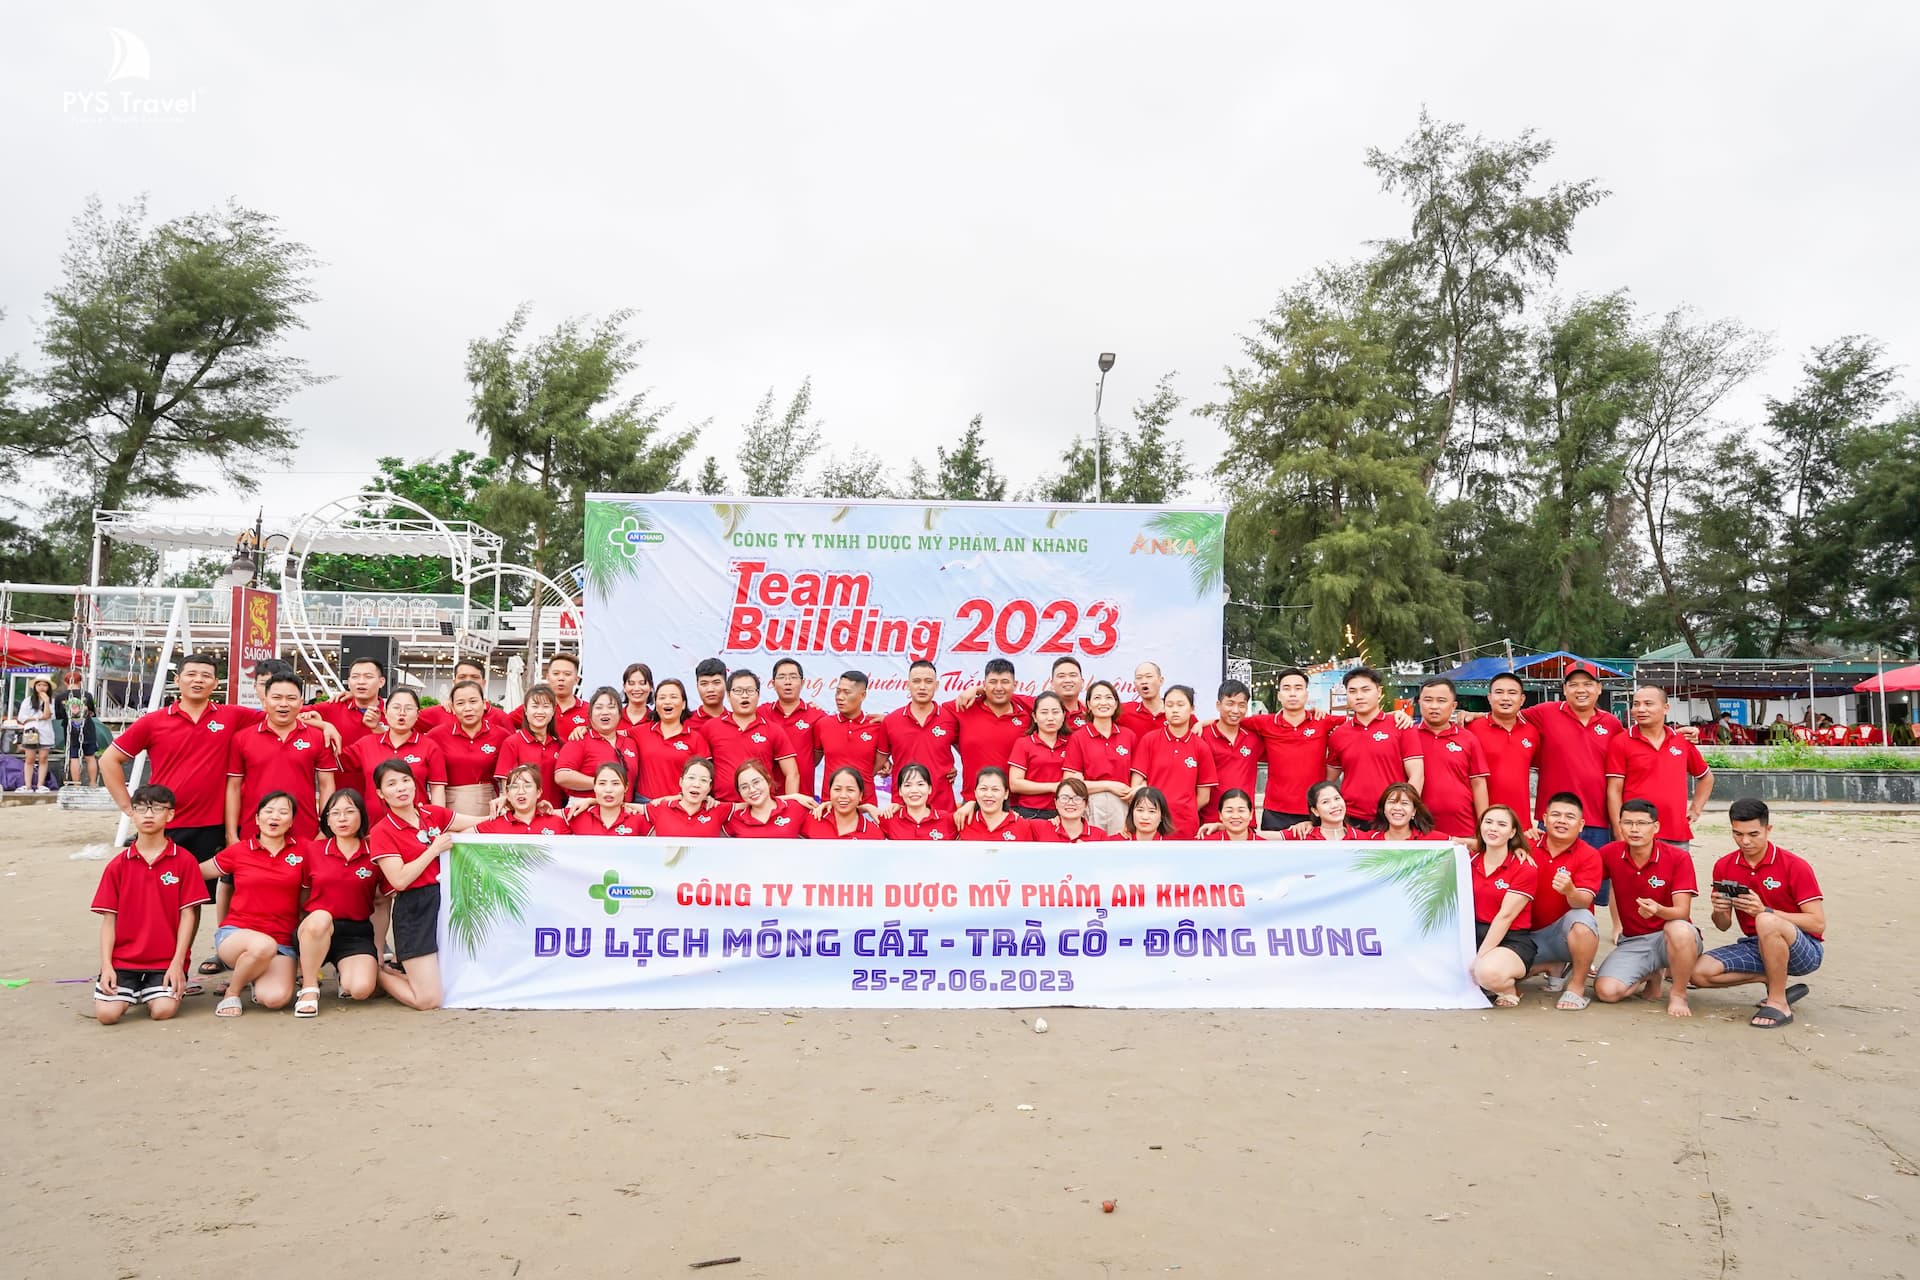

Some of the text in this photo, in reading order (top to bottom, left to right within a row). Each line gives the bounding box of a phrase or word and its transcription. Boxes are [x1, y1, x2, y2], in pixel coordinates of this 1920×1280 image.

[733, 529, 1088, 553] CÔNG TY TNHH DƯỢC MỸ PHẨM AN KHANG
[1129, 531, 1198, 555] ANKA
[729, 561, 871, 606] Team
[726, 598, 1120, 662] Building 2023
[243, 646, 272, 661] SAIGON
[611, 888, 652, 896] AN KHANG
[676, 874, 1246, 912] CÔNG TY TNHH DƯỢC MỸ PHẨM AN KHANG
[534, 927, 592, 958] DU
[604, 927, 709, 968] LỊCH
[854, 919, 929, 957] CÁI
[940, 938, 955, 948] -
[965, 919, 1046, 957] TRÀ
[1058, 908, 1108, 957] CỔ
[1119, 938, 1133, 947] -
[1143, 918, 1257, 957] ĐÔNG
[1267, 925, 1383, 957] HƯNG
[851, 969, 1075, 991] 25-27.06.2023
